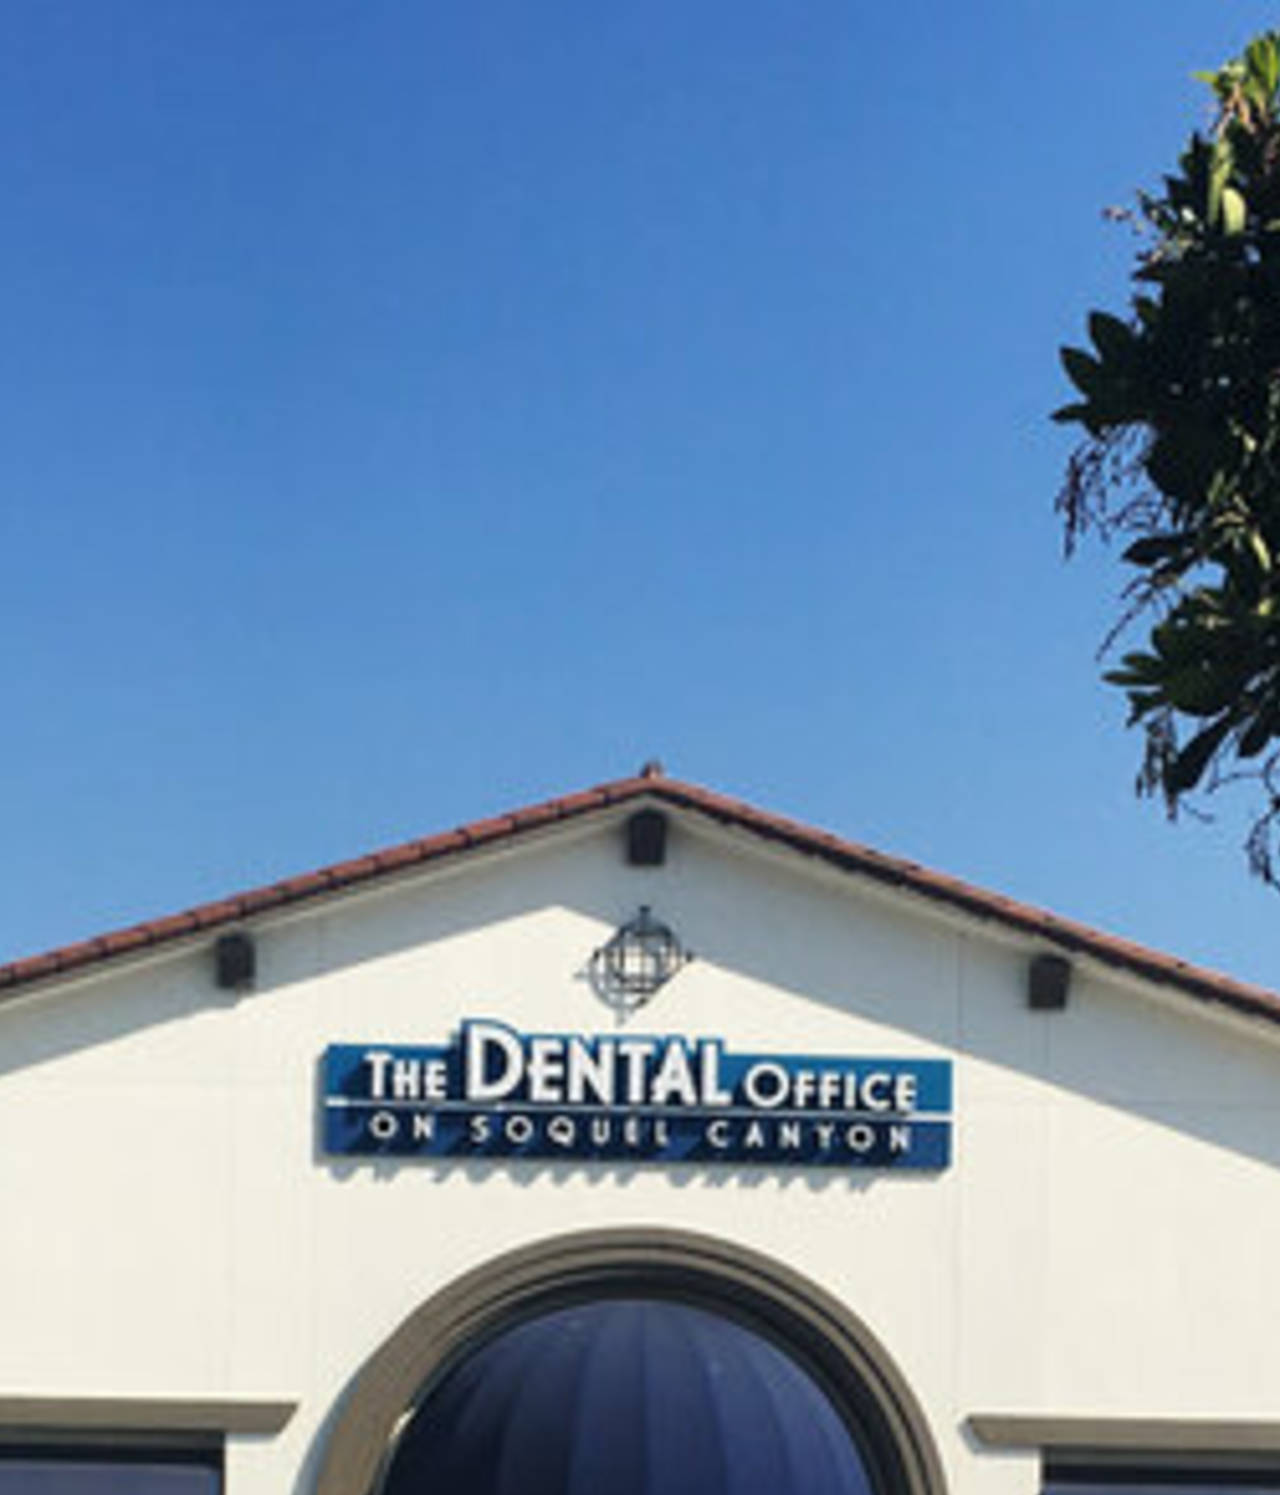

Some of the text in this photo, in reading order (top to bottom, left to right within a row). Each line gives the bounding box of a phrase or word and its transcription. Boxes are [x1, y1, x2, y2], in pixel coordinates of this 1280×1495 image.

[365, 1022, 918, 1112] THE DENTAL OFFICE
[370, 1111, 912, 1151] ON SOQUEL CANYON
